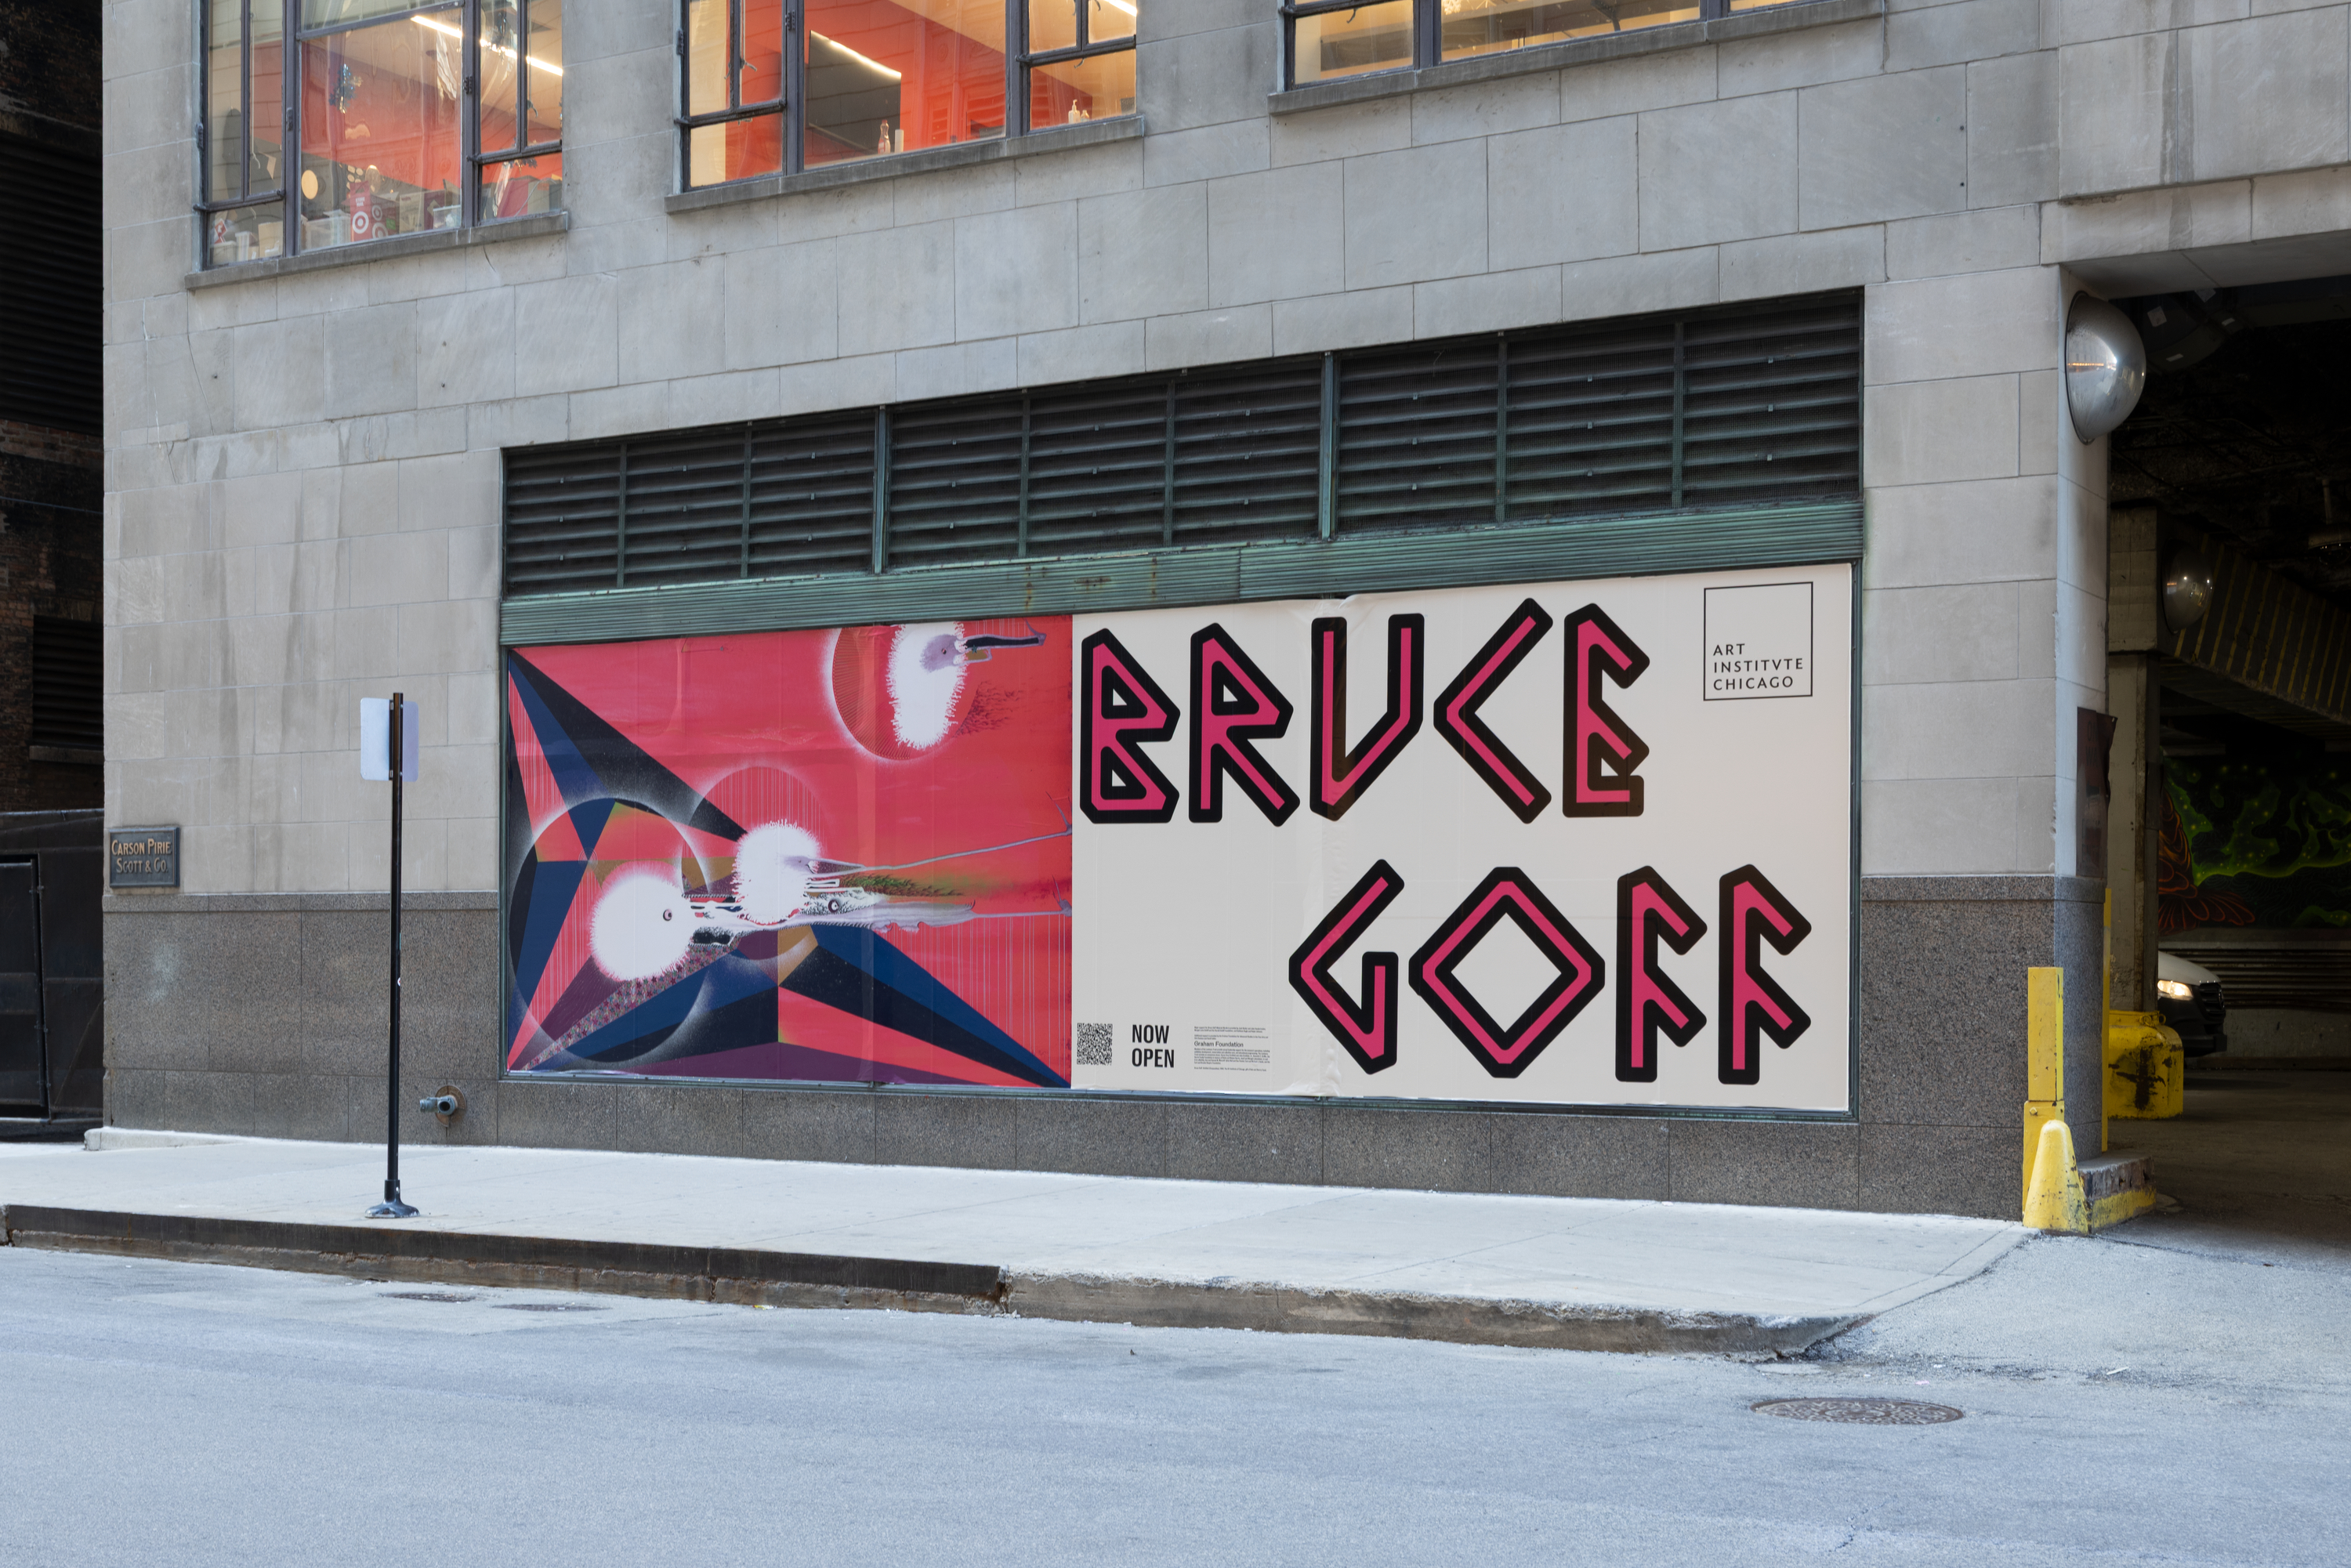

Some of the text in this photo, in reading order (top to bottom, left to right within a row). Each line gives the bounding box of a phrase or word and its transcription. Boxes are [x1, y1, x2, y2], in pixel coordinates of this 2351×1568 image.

[1713, 643, 1745, 656] ART
[1714, 658, 1803, 674] INSTITVTE
[1713, 676, 1793, 690] CHICAGO
[1080, 598, 1650, 827] BRUCE
[111, 838, 172, 856] CARSON PIRIE
[117, 858, 143, 874] SCOTT
[145, 860, 152, 873] &
[1289, 859, 1811, 1085] GOFF
[1132, 1024, 1170, 1044] NOW
[1132, 1048, 1175, 1068] OPEN
